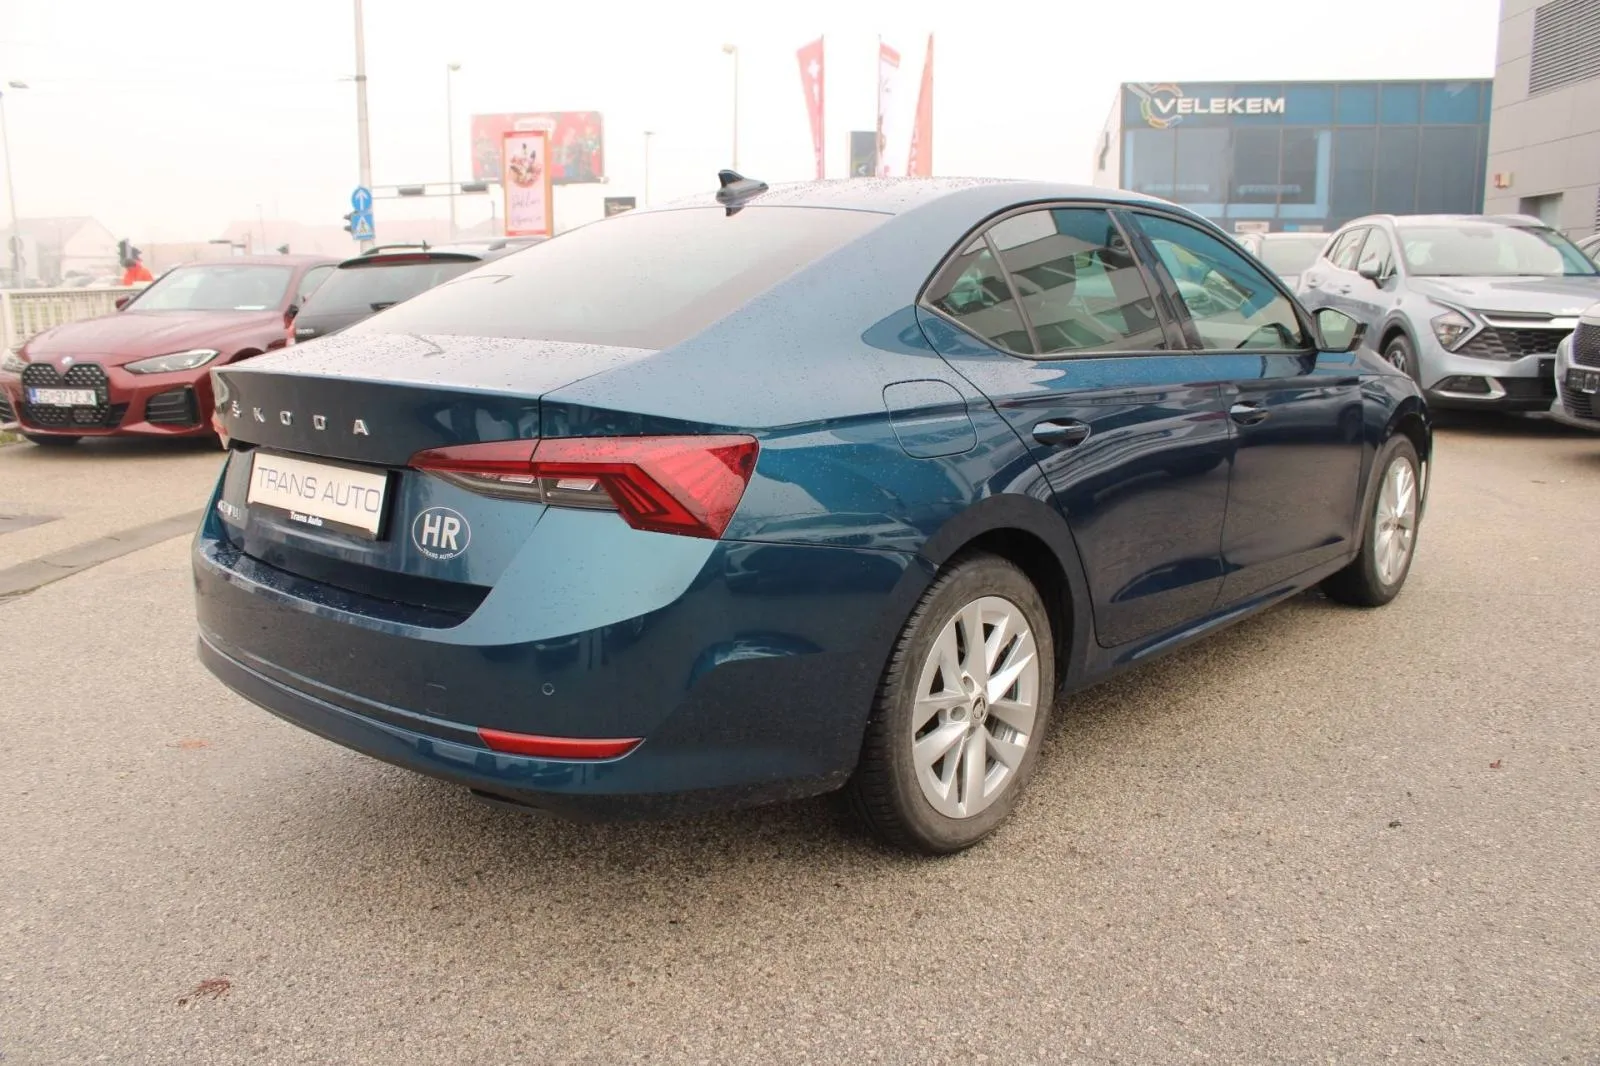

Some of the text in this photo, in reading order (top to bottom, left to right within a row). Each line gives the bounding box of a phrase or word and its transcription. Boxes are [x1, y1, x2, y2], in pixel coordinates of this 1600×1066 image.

[1154, 97, 1286, 114] VELEKEM
[258, 466, 381, 514] TRANS AUTO
[290, 510, 323, 527] Trans Auto
[421, 513, 461, 551] HR
[423, 547, 454, 560] TRANS AUTO
